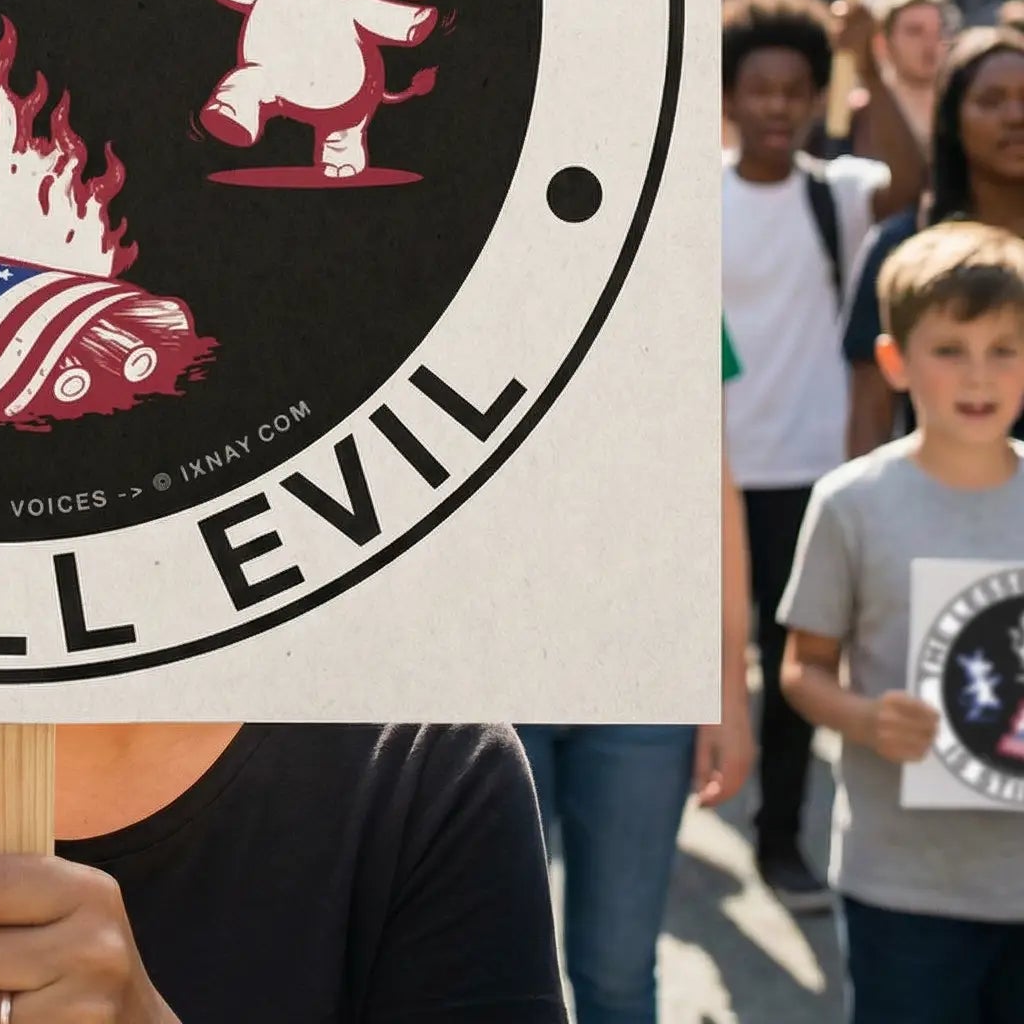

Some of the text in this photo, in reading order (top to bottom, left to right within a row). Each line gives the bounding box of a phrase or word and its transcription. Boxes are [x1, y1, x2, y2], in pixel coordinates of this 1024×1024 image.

[10, 489, 107, 517] VOICES
[180, 435, 250, 482] IXNAY
[197, 364, 528, 612] EVIL
